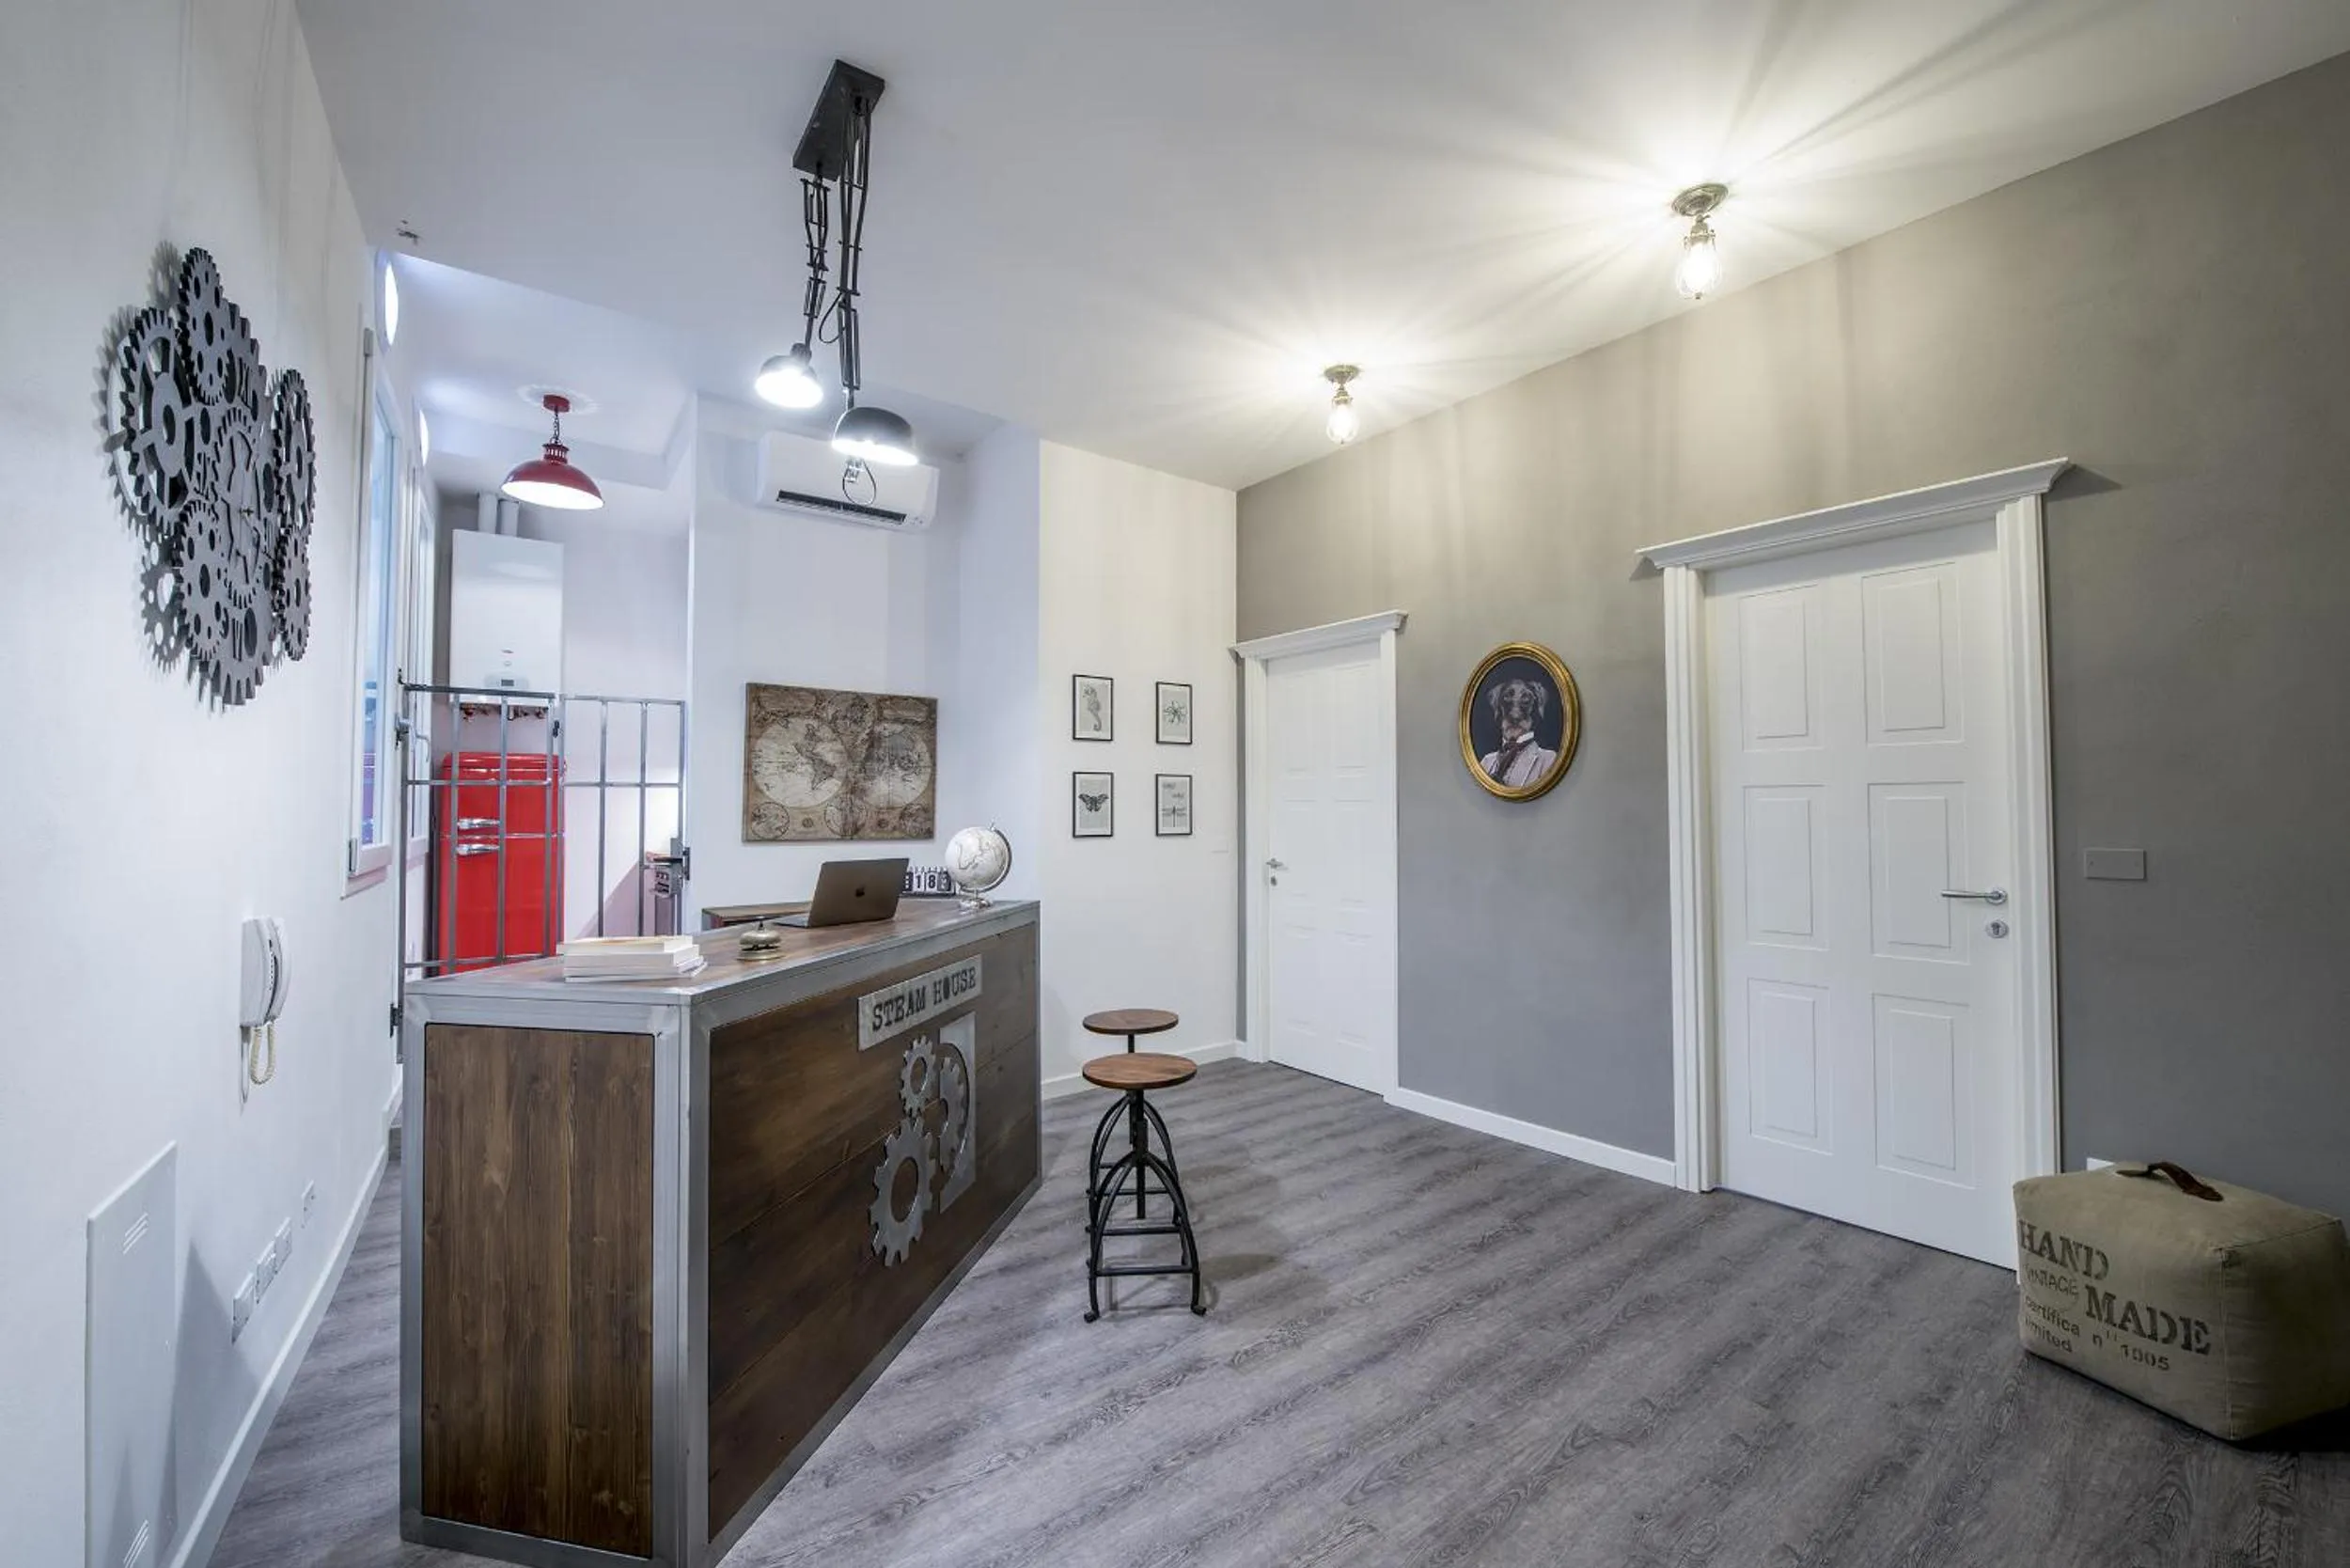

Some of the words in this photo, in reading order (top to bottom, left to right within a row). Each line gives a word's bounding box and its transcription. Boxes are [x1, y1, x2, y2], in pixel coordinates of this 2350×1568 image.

[871, 985, 927, 1031] STEAM
[932, 966, 977, 1006] HOUSE
[2018, 1219, 2109, 1279] HAND
[2085, 1284, 2211, 1356] MADE
